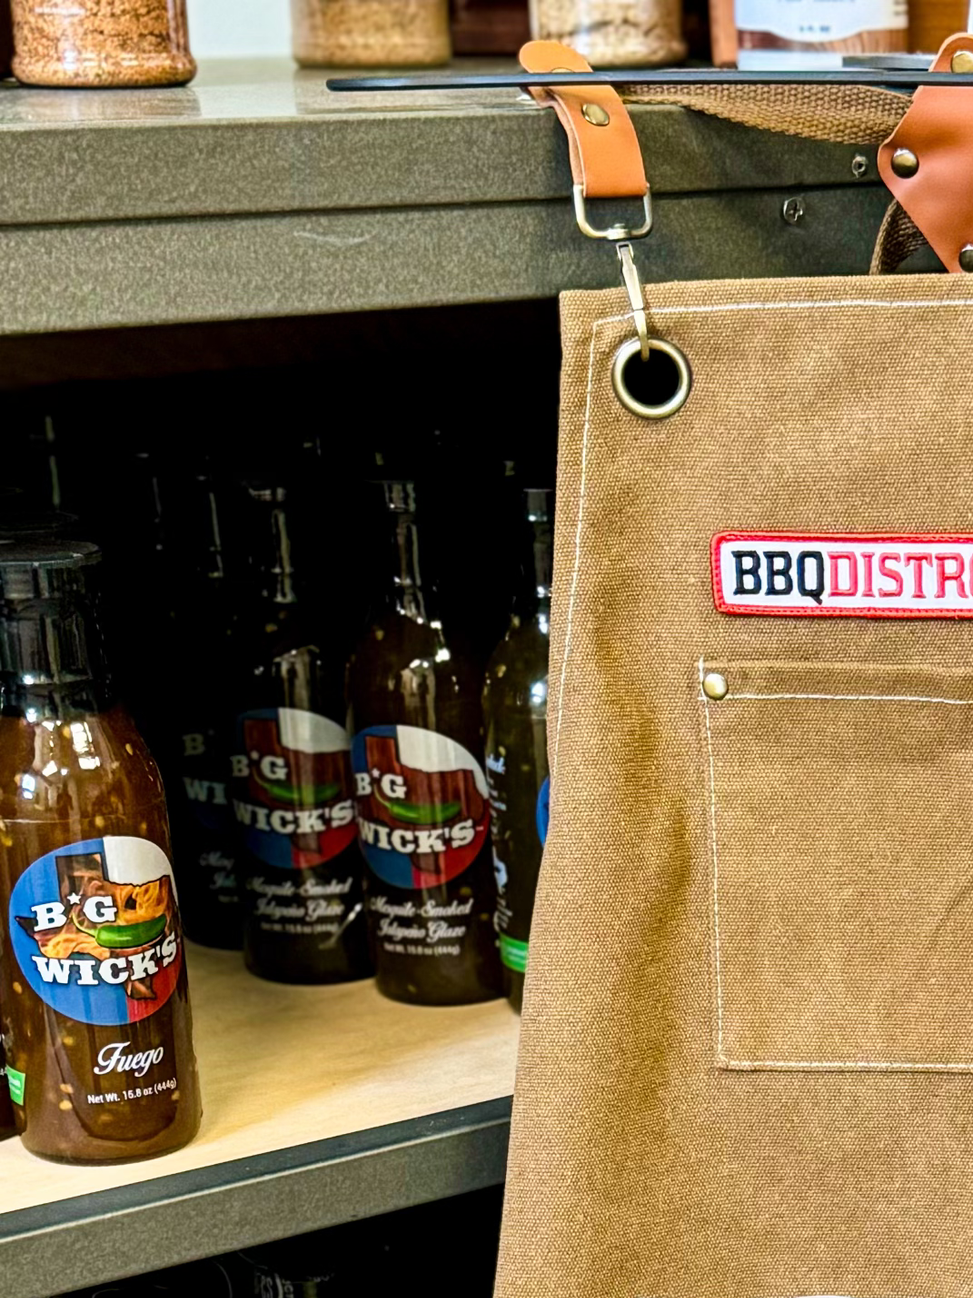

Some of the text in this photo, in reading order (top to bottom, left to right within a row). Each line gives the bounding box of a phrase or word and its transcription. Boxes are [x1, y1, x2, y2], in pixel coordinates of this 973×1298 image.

[233, 799, 354, 834] WICK'S
[358, 819, 475, 853] WICK'S
[31, 931, 177, 986] WICK'S
[94, 1041, 164, 1077] Fuego
[87, 1077, 177, 1104] Net Wt. 15.8 oz (444g)
